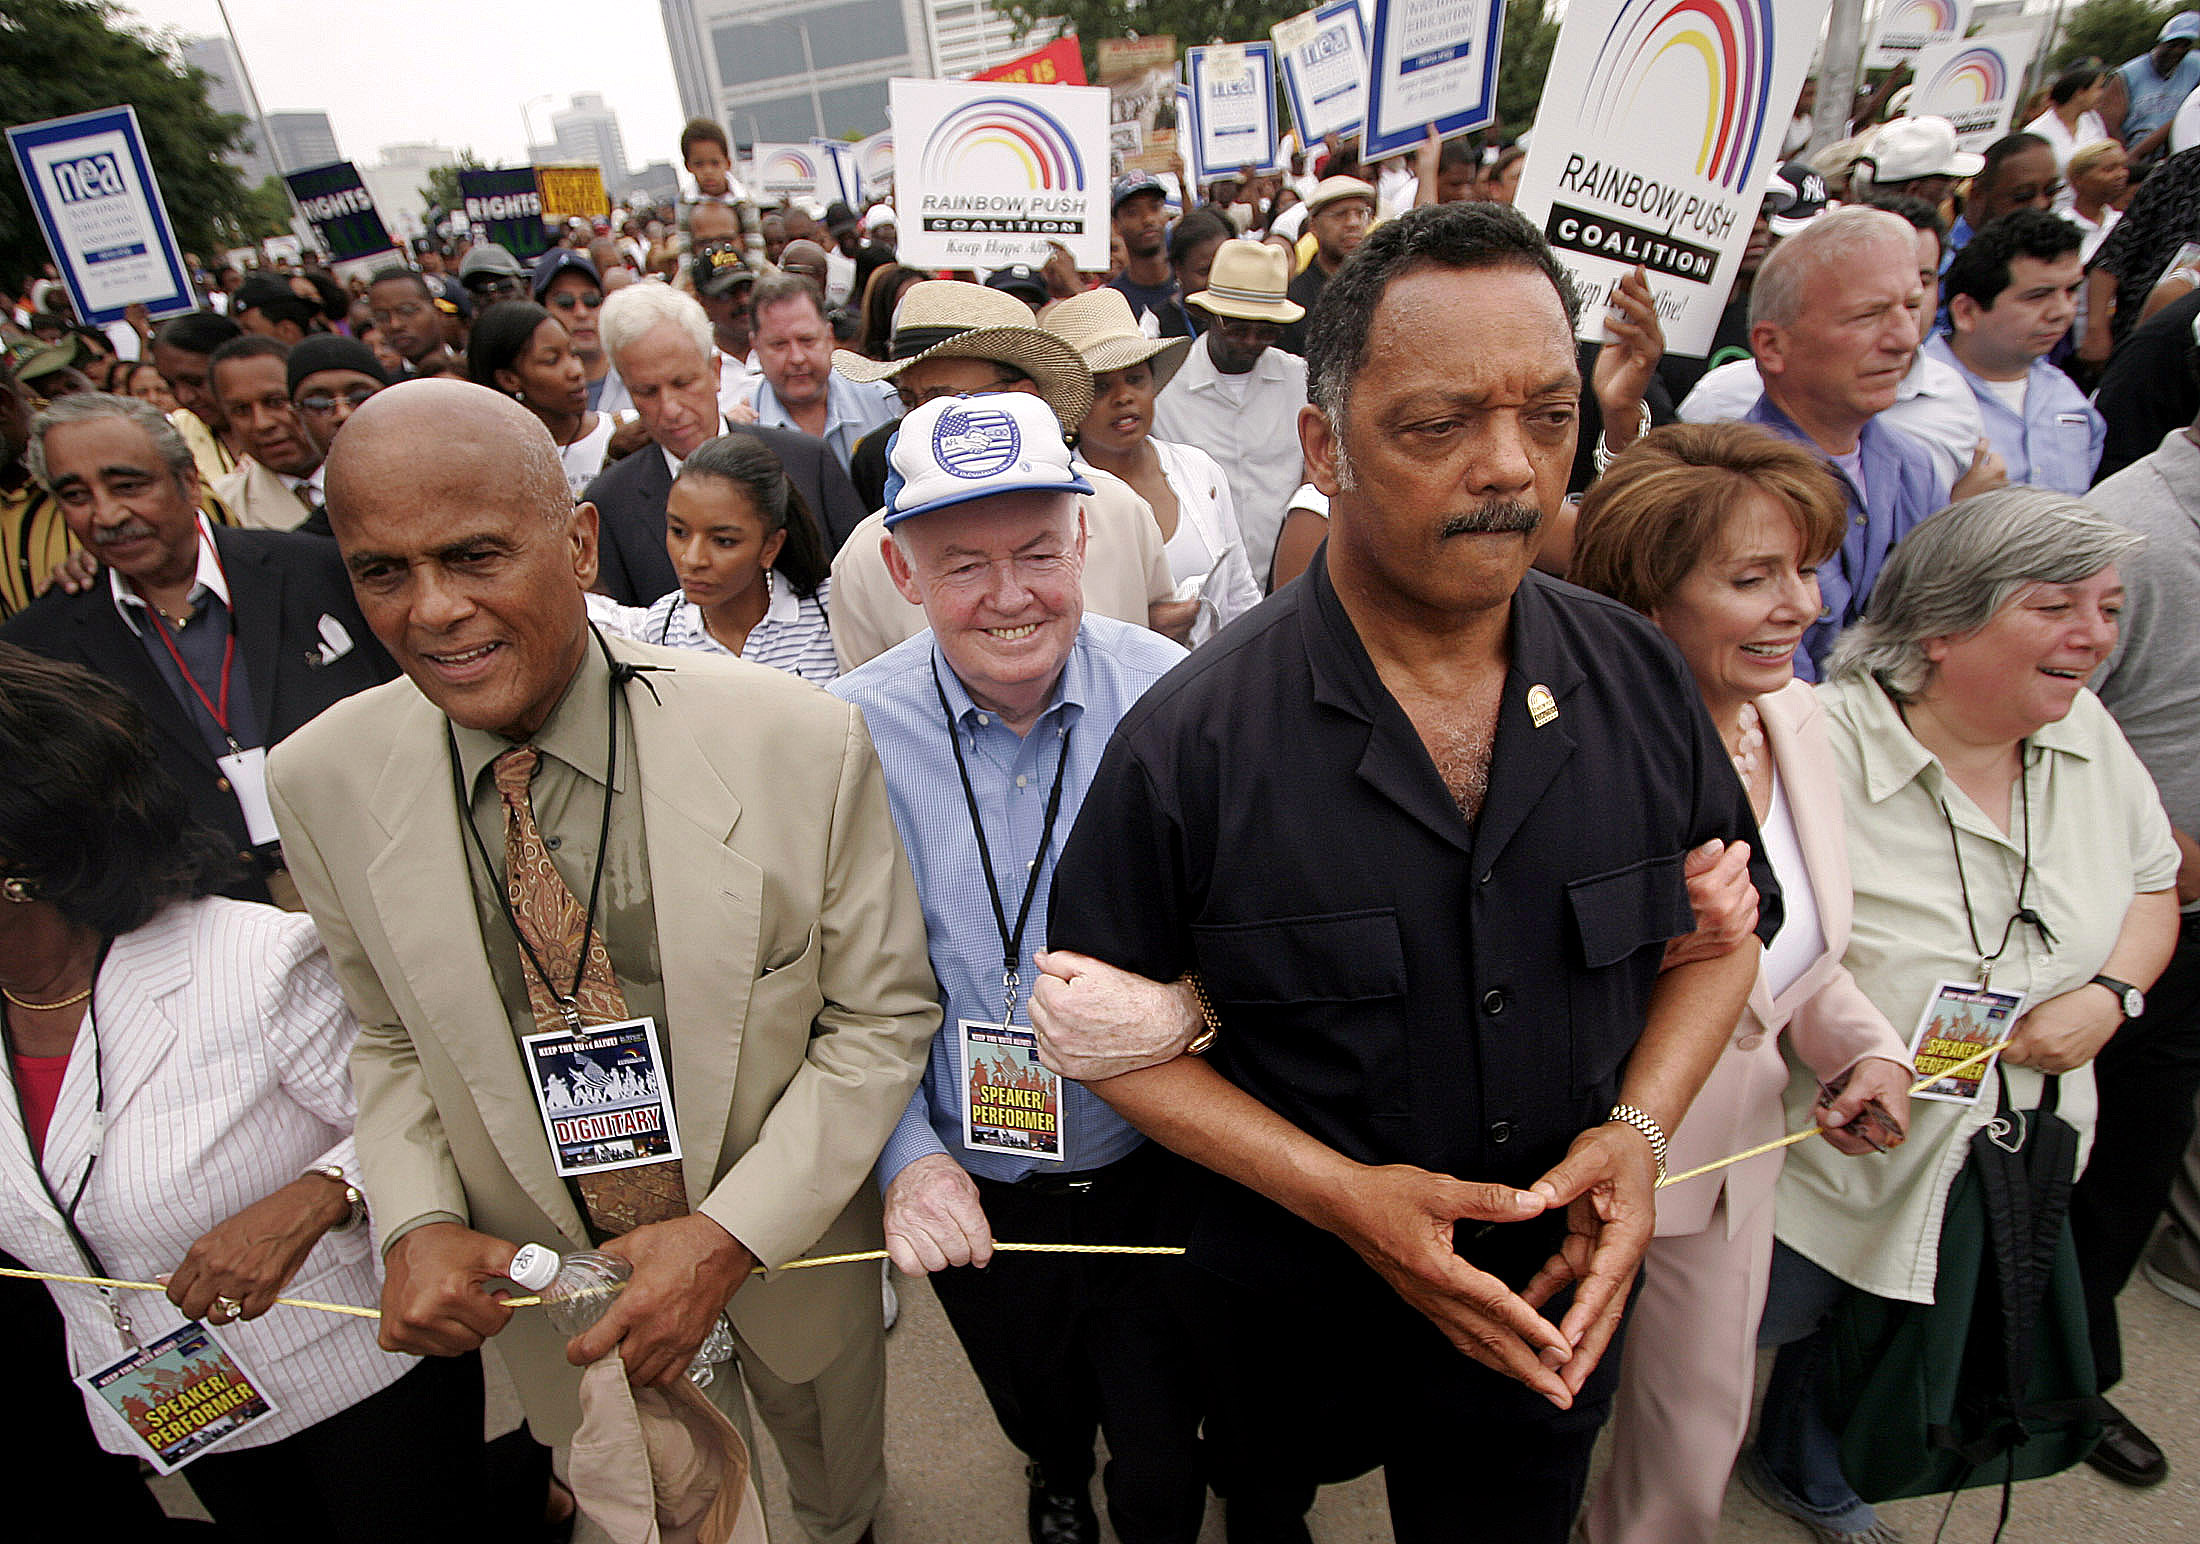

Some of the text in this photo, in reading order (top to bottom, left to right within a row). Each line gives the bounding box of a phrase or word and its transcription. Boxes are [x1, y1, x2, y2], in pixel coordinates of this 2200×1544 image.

[1303, 27, 1349, 66] nea
[55, 155, 125, 203] nea
[1559, 153, 1683, 219] RAINBOW
[465, 191, 543, 222] RIGHTS
[922, 195, 1025, 211] RAINBOW
[932, 219, 1077, 233] COALITION
[1557, 218, 1710, 276] COALITION
[972, 1104, 1055, 1132] PERFORMER
[980, 1085, 1046, 1112] SPEAKER/
[554, 1105, 661, 1144] DIGNITARY
[145, 1372, 231, 1428] SPEAKER/
[147, 1382, 255, 1450] PERFORMER
